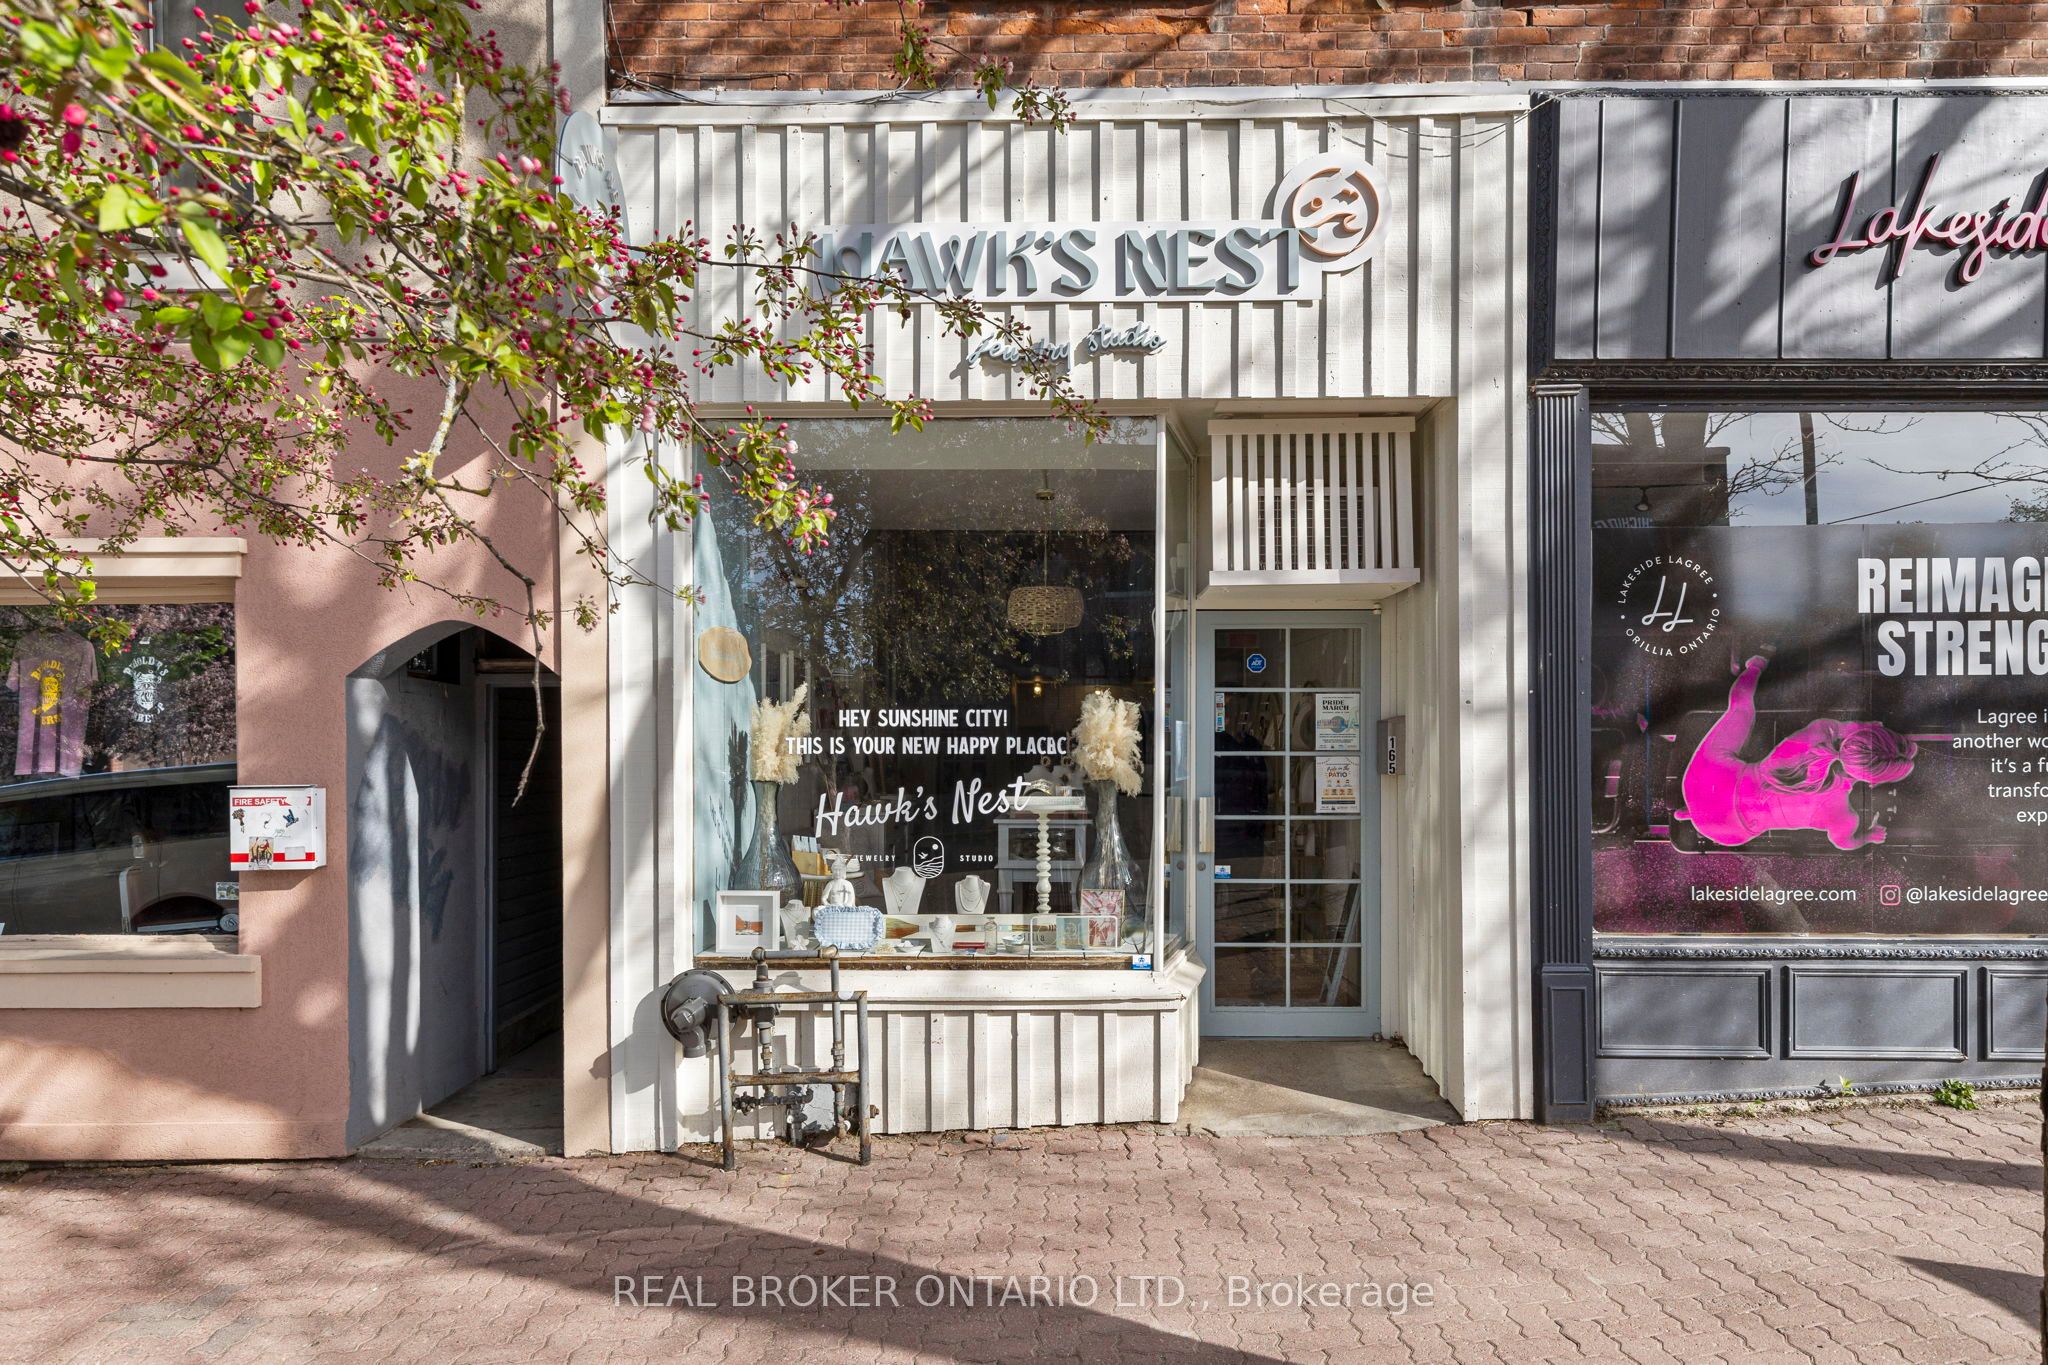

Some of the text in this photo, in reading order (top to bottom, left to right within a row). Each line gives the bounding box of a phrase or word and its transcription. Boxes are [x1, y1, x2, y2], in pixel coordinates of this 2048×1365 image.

[1808, 151, 2048, 286] Lakesid
[812, 227, 1318, 296] HAWK'S NEST
[1088, 321, 1167, 355] studio
[1617, 555, 1713, 604] LAKESIDE LAGREE
[1626, 608, 1720, 657] ORILLIA ONTARIO
[838, 709, 1008, 728] HEY SUNSHINE CITY!
[1977, 708, 2038, 729] Lagree
[785, 736, 823, 755] THIS
[829, 736, 846, 755] IS
[852, 736, 896, 755] YOUR
[901, 736, 941, 755] NEW
[946, 736, 999, 755] HAPPY
[1952, 732, 2023, 749] another
[1388, 736, 1396, 774] 165
[1991, 757, 2017, 774] it's
[2022, 760, 2032, 773] a
[1987, 782, 2048, 798] transfo
[234, 798, 253, 806] FIRE
[815, 775, 1032, 839] Hawk's Nest
[2016, 810, 2048, 827] exp
[959, 854, 994, 862] STUDIO
[1690, 885, 2048, 905] lakesidelagree.com @lakesidelagree
